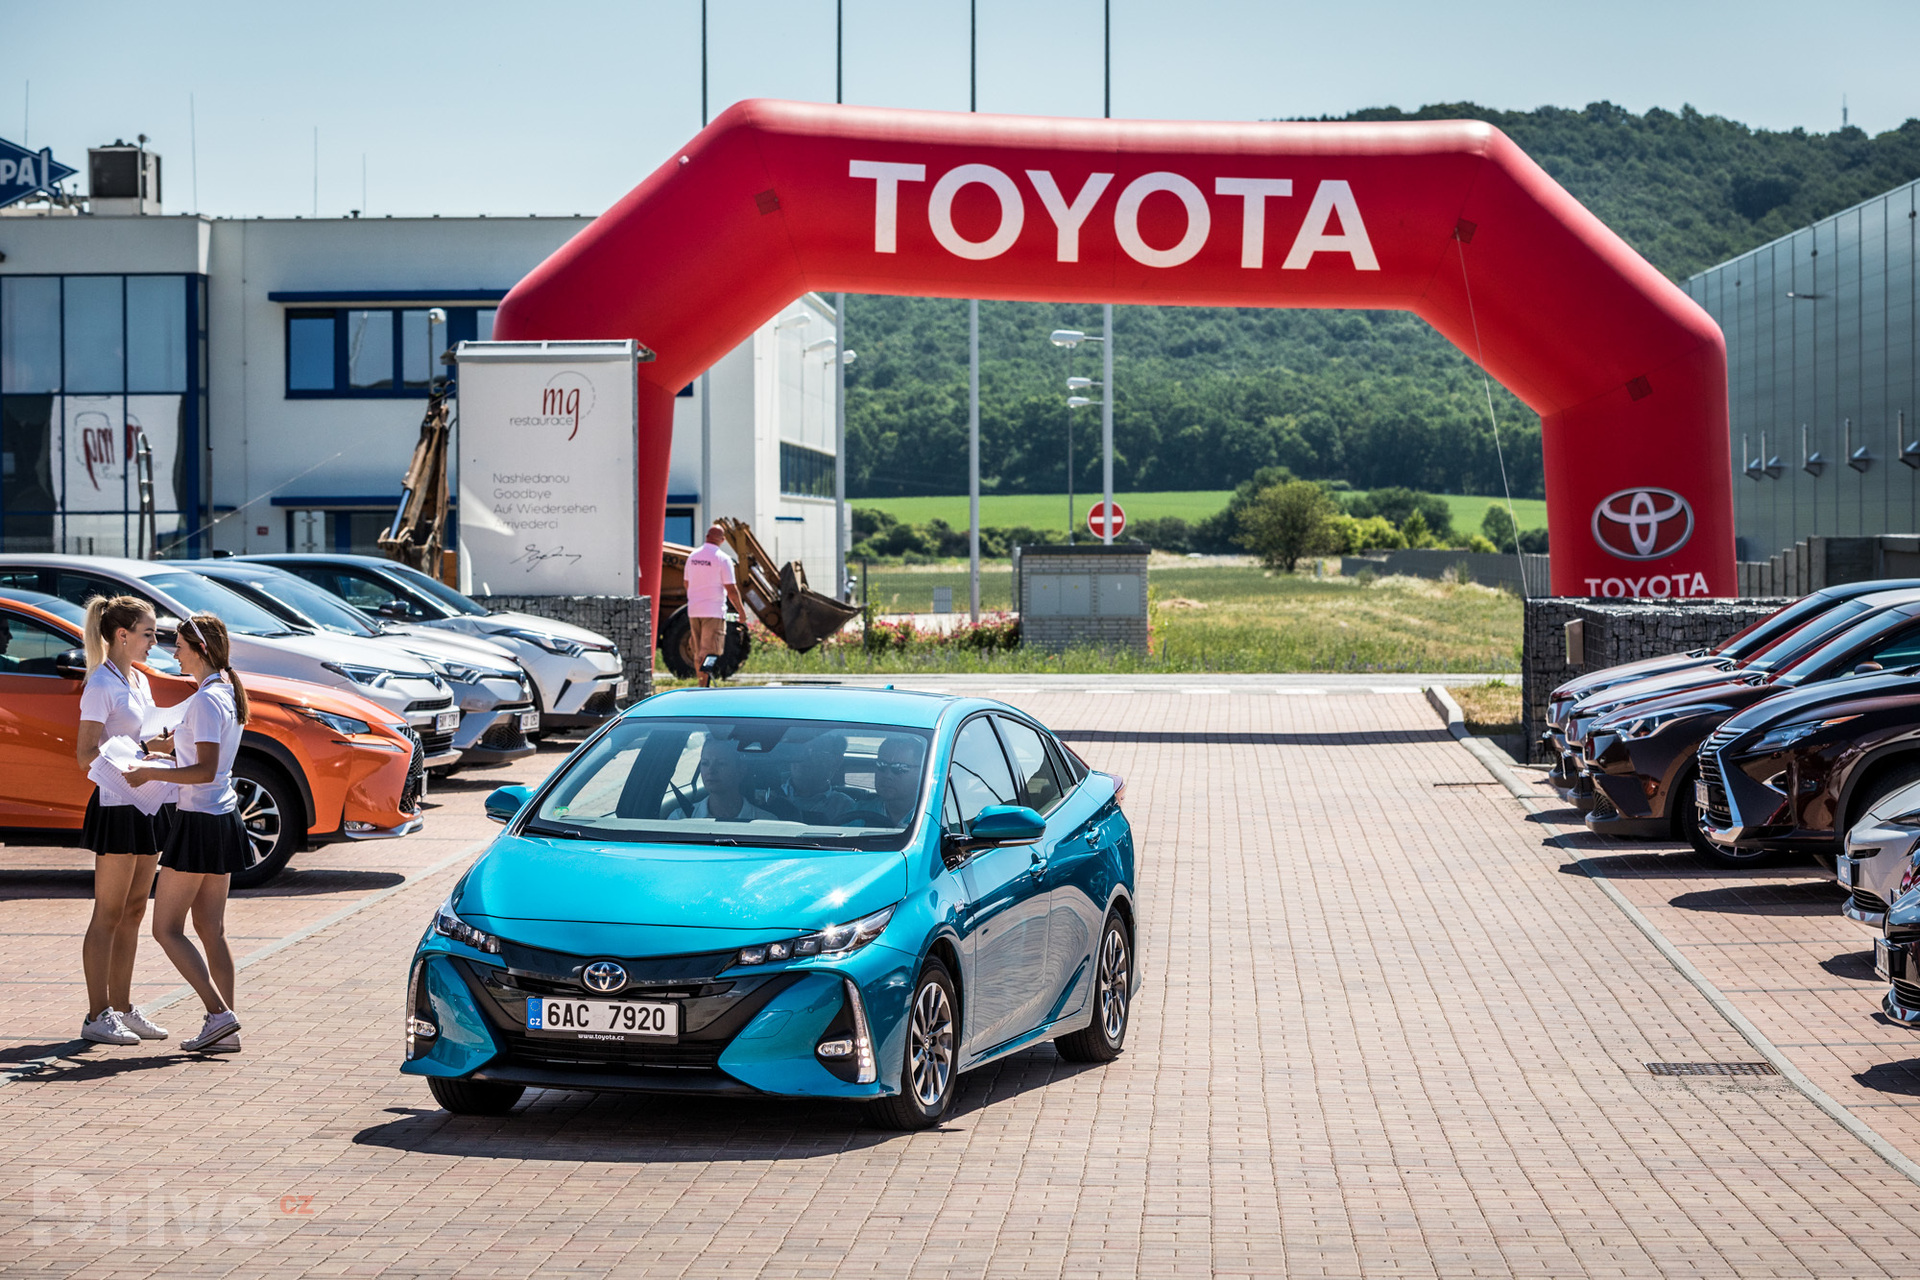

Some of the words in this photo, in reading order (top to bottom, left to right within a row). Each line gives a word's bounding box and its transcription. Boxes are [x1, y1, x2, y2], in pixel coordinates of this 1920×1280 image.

[849, 160, 1381, 271] TOYOTA
[542, 388, 581, 441] mg
[509, 416, 574, 426] restaurace
[493, 473, 570, 484] Nashledanou
[493, 488, 552, 501] Goodbye
[493, 503, 513, 515] Auf
[516, 503, 597, 514] Wiedersehen
[691, 559, 712, 567] TOYOTA
[1584, 572, 1709, 598] TOYOTA
[529, 1018, 541, 1026] CZ
[547, 1002, 590, 1028] 6AC
[608, 1005, 666, 1031] 7920
[578, 1033, 625, 1042] www.toyota.cz
